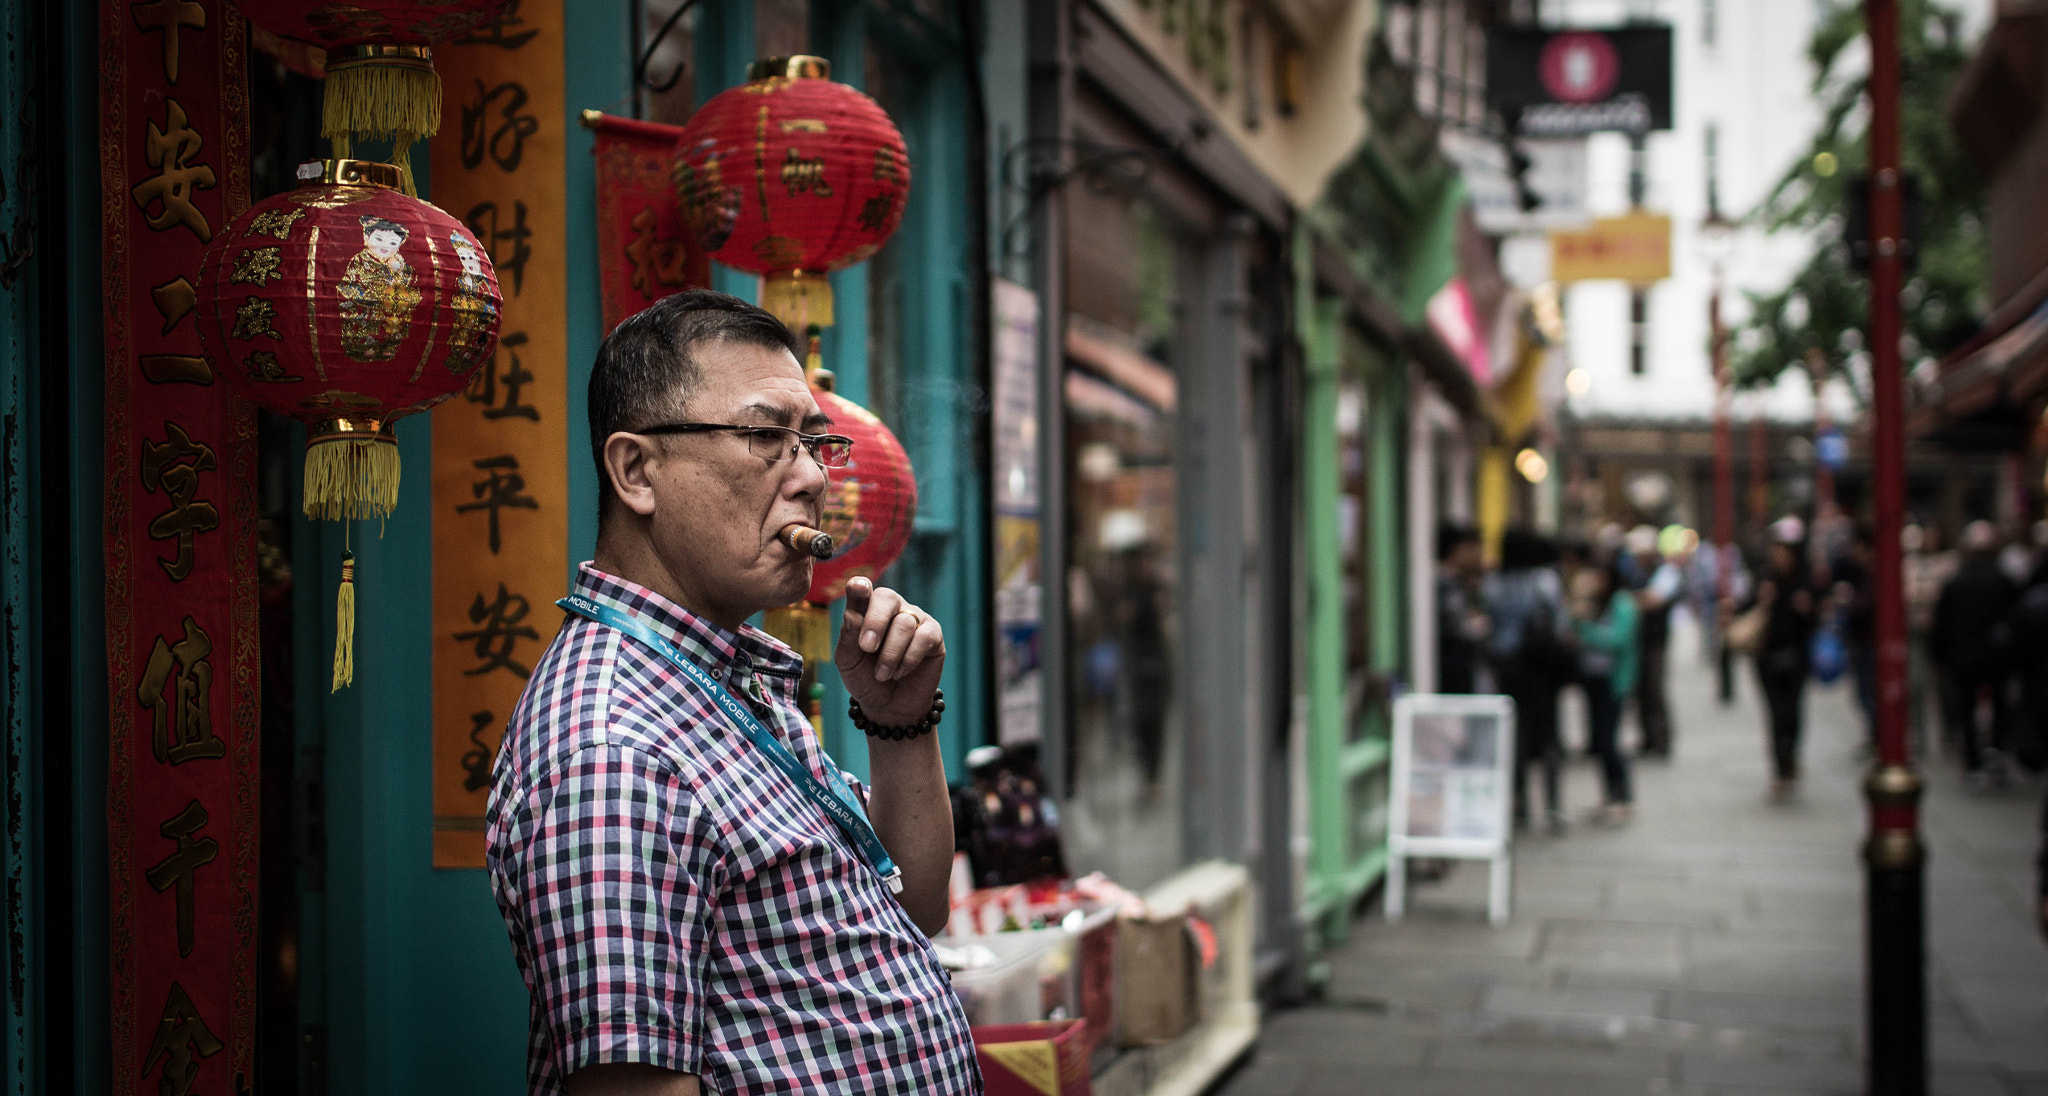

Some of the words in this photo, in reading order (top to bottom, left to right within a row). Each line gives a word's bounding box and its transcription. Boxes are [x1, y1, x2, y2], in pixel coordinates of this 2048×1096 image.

[568, 595, 600, 615] MOBILE
[673, 652, 719, 695] LEBARA
[719, 693, 759, 735] MOBILE
[815, 789, 853, 826] LEBARA
